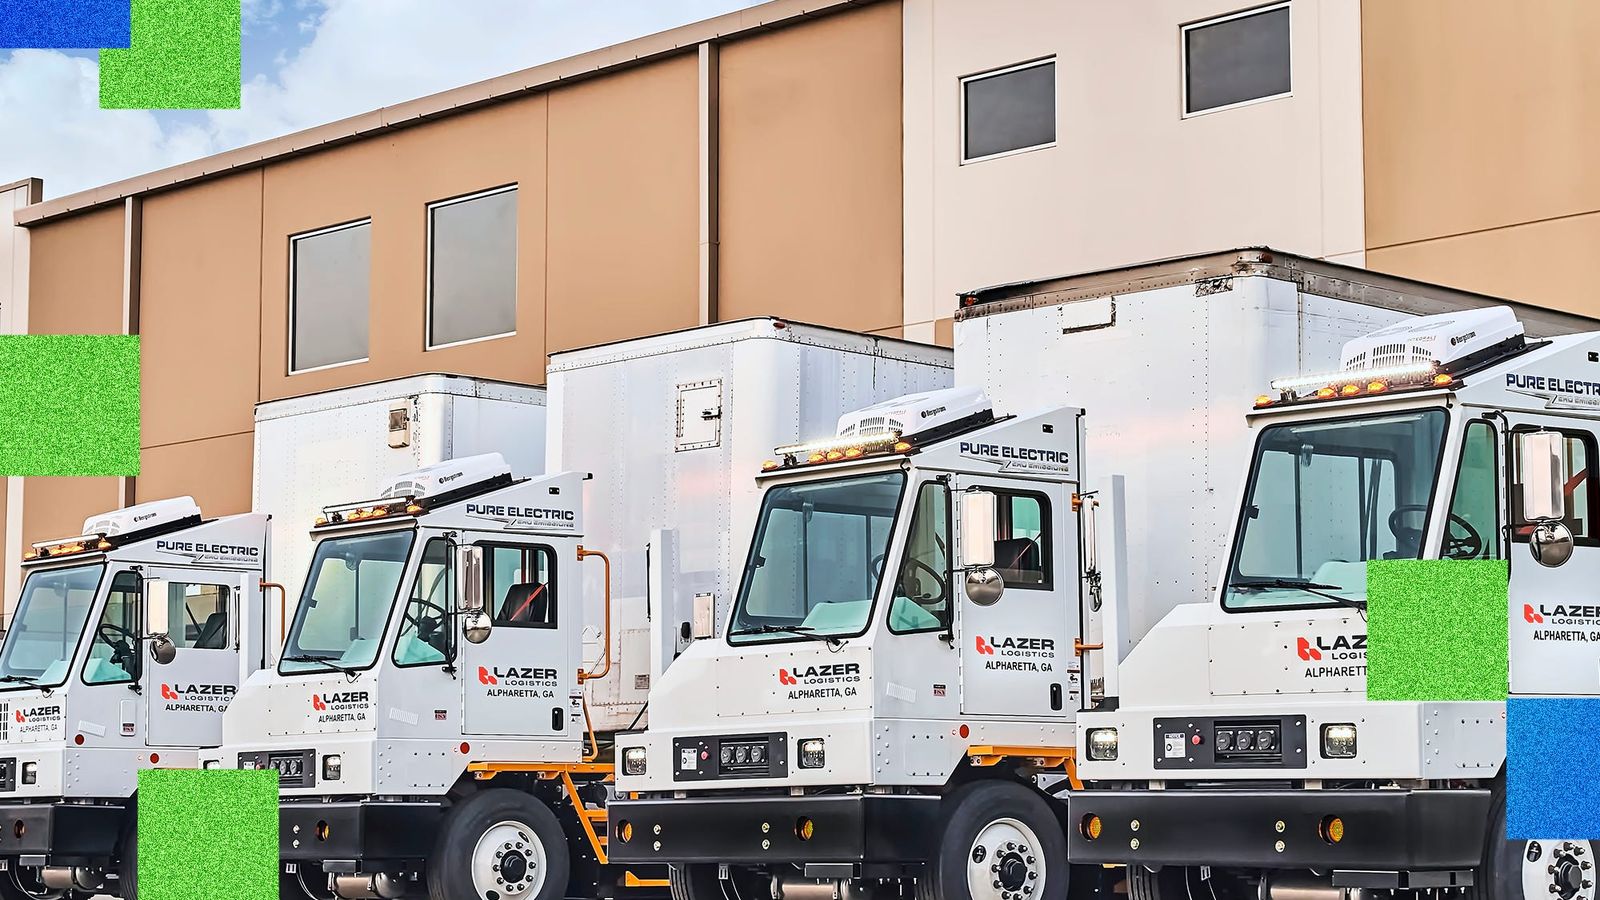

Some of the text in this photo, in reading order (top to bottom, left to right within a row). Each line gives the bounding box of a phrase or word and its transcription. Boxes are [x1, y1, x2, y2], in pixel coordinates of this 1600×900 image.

[1506, 373, 1600, 396] PURE ELECTR
[960, 442, 1069, 463] PURE ELECTRIC
[466, 504, 574, 521] PURE ELECTRIC
[156, 540, 259, 557] PURE ELECTRIC
[1551, 618, 1600, 626] LOGISTIC
[1316, 634, 1368, 651] LAZ
[1533, 630, 1589, 643] ALPHARETTA,
[990, 636, 1055, 651] LAZER
[1001, 650, 1055, 659] LOGISTICS
[493, 666, 558, 680] LAZER
[793, 662, 860, 678] LAZER
[985, 660, 1053, 673] ALPHARETTA, GA
[1304, 665, 1368, 678] ALPHARETT
[504, 679, 558, 687] LOGISTICS
[803, 675, 861, 685] LOGISTICS
[174, 683, 238, 696] LAZER
[486, 688, 555, 699] ALPHARETTA, GA
[787, 686, 857, 700] ALPHARETTA, GA
[323, 691, 369, 704] LAZER
[22, 705, 61, 718] LAZER
[165, 703, 217, 713] ALPHARETTA,
[330, 702, 369, 711] LOGISTICS
[28, 715, 61, 723] LOGISTICS
[318, 712, 366, 723] ALPHARETTA, GA
